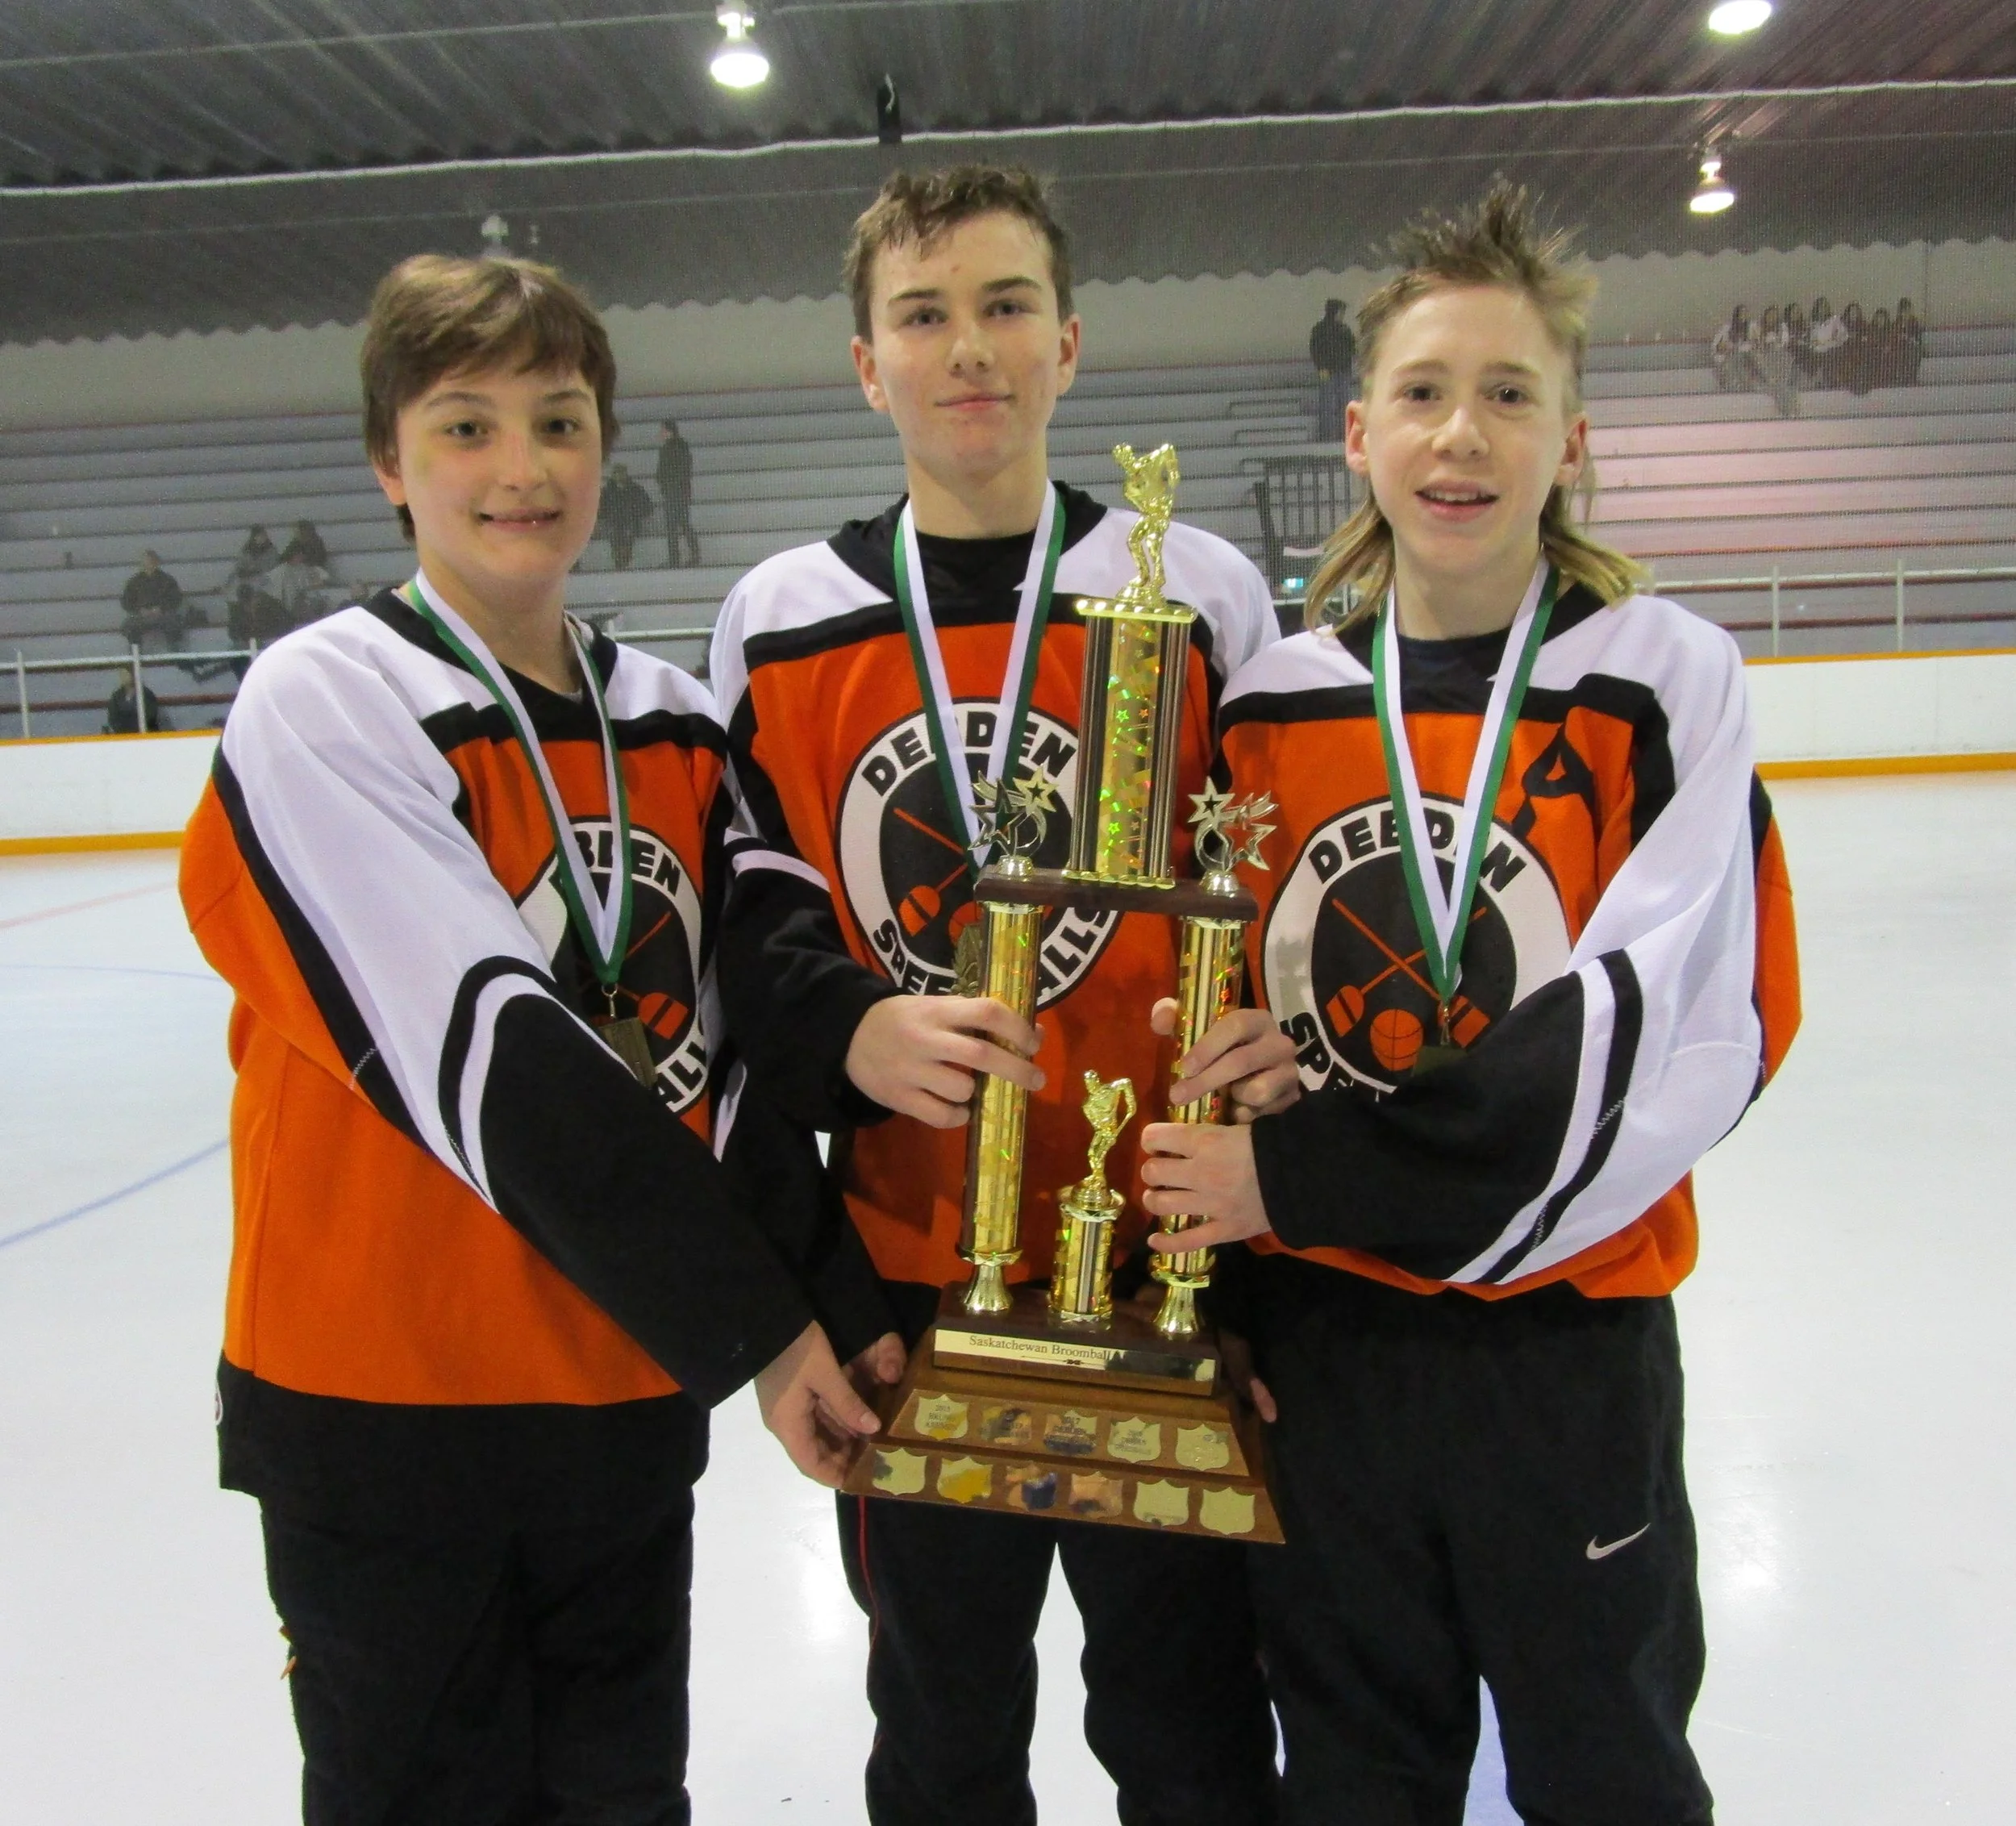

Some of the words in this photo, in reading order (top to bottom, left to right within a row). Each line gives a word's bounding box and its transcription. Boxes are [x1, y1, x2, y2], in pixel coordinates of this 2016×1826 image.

[862, 710, 1077, 797] DEDEN
[969, 1334, 1048, 1354] Saskatchewan
[1051, 1344, 1111, 1361] Broomball
